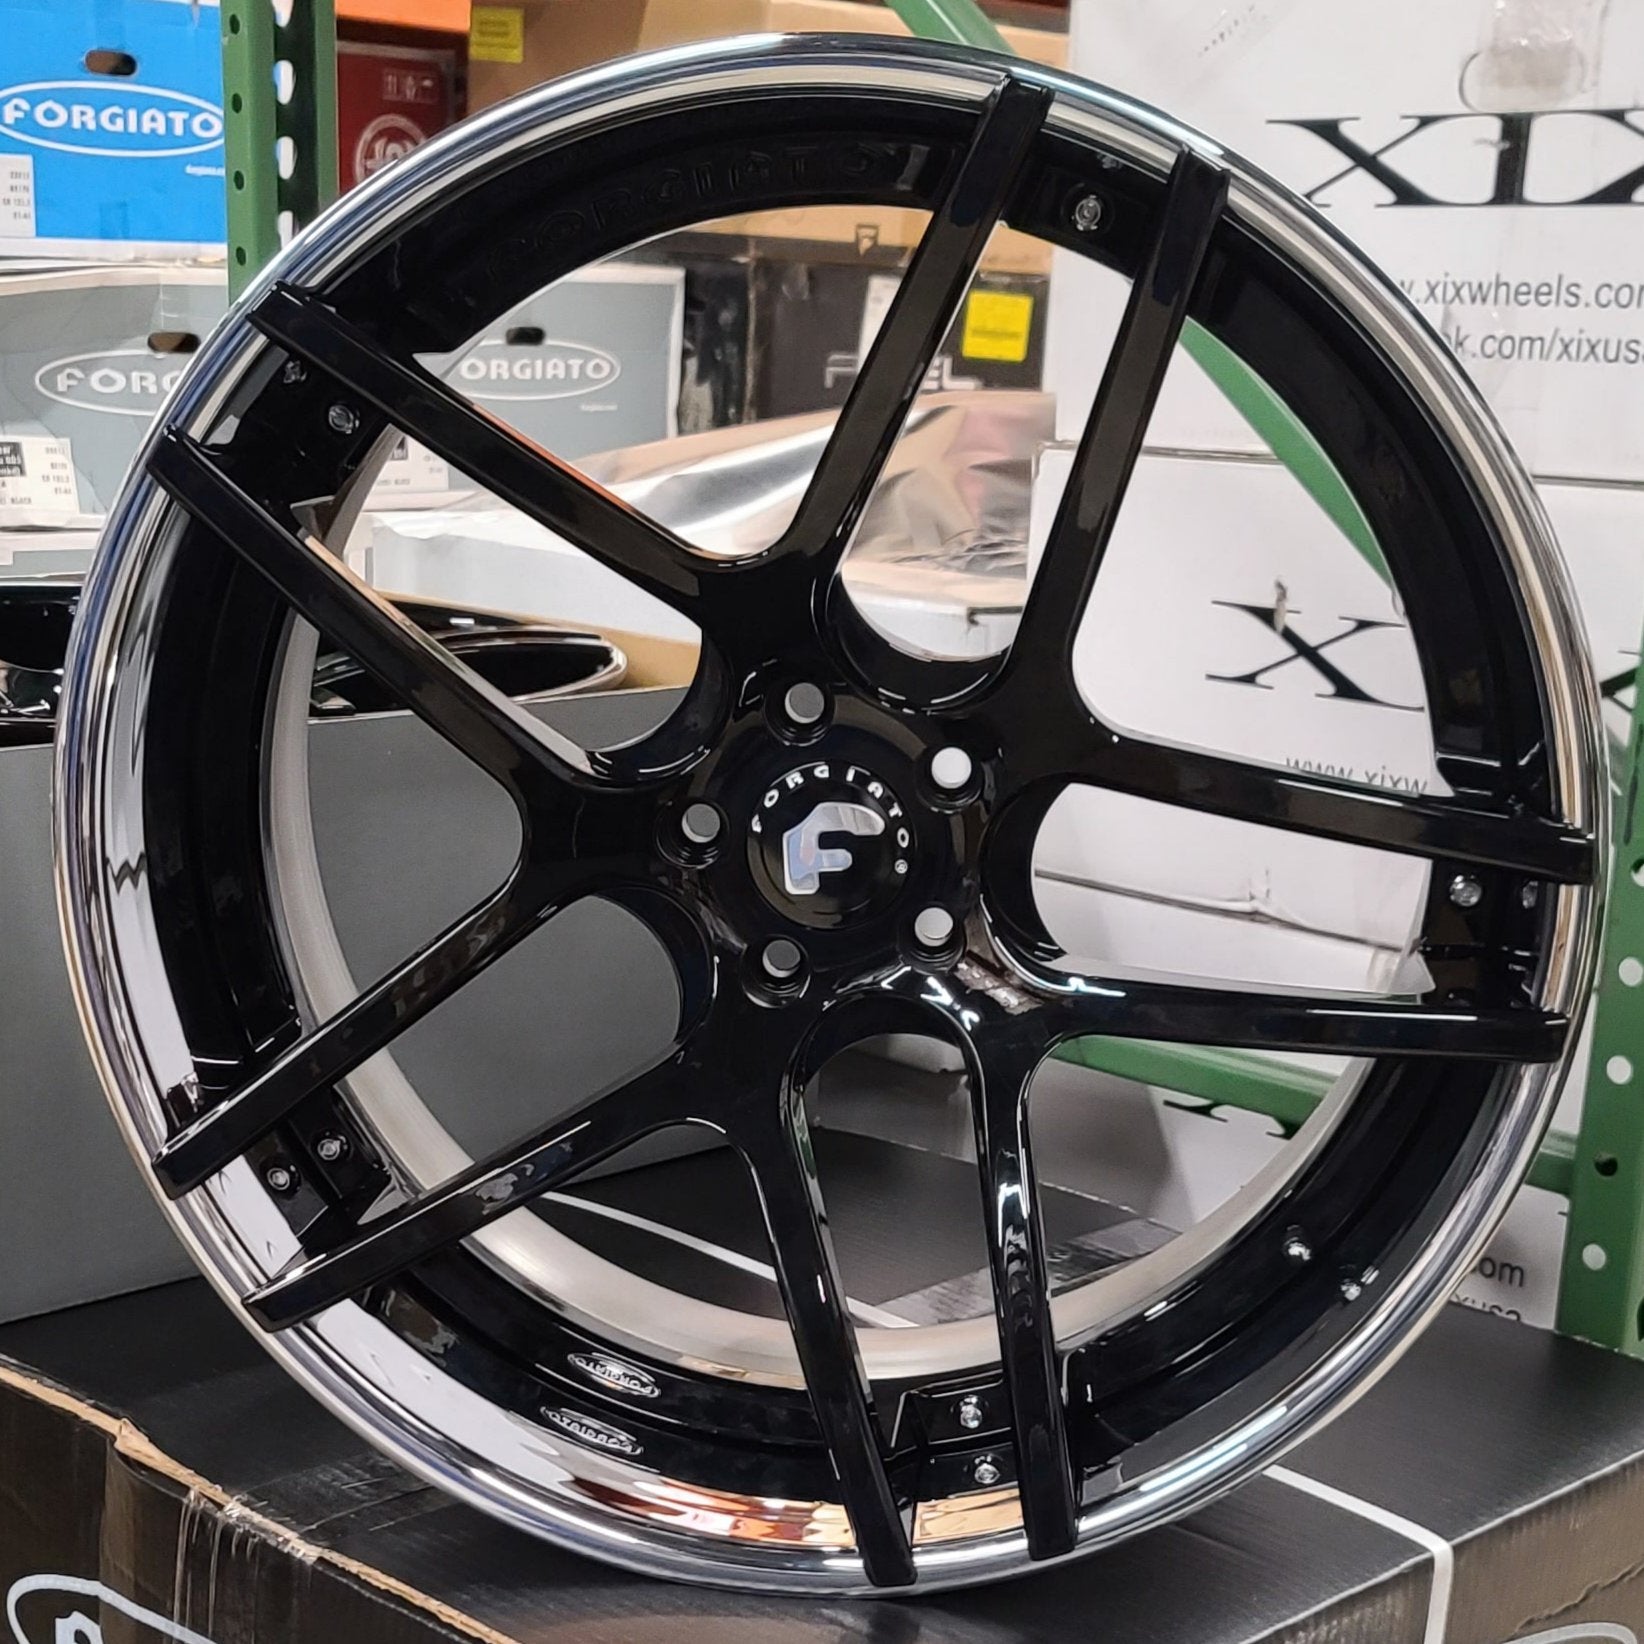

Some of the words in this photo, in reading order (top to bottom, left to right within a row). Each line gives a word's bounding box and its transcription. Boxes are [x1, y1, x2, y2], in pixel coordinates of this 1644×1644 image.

[2, 97, 224, 138] FORGIATO
[460, 358, 611, 380] ORGIATO
[751, 764, 910, 848] FORGIATO
